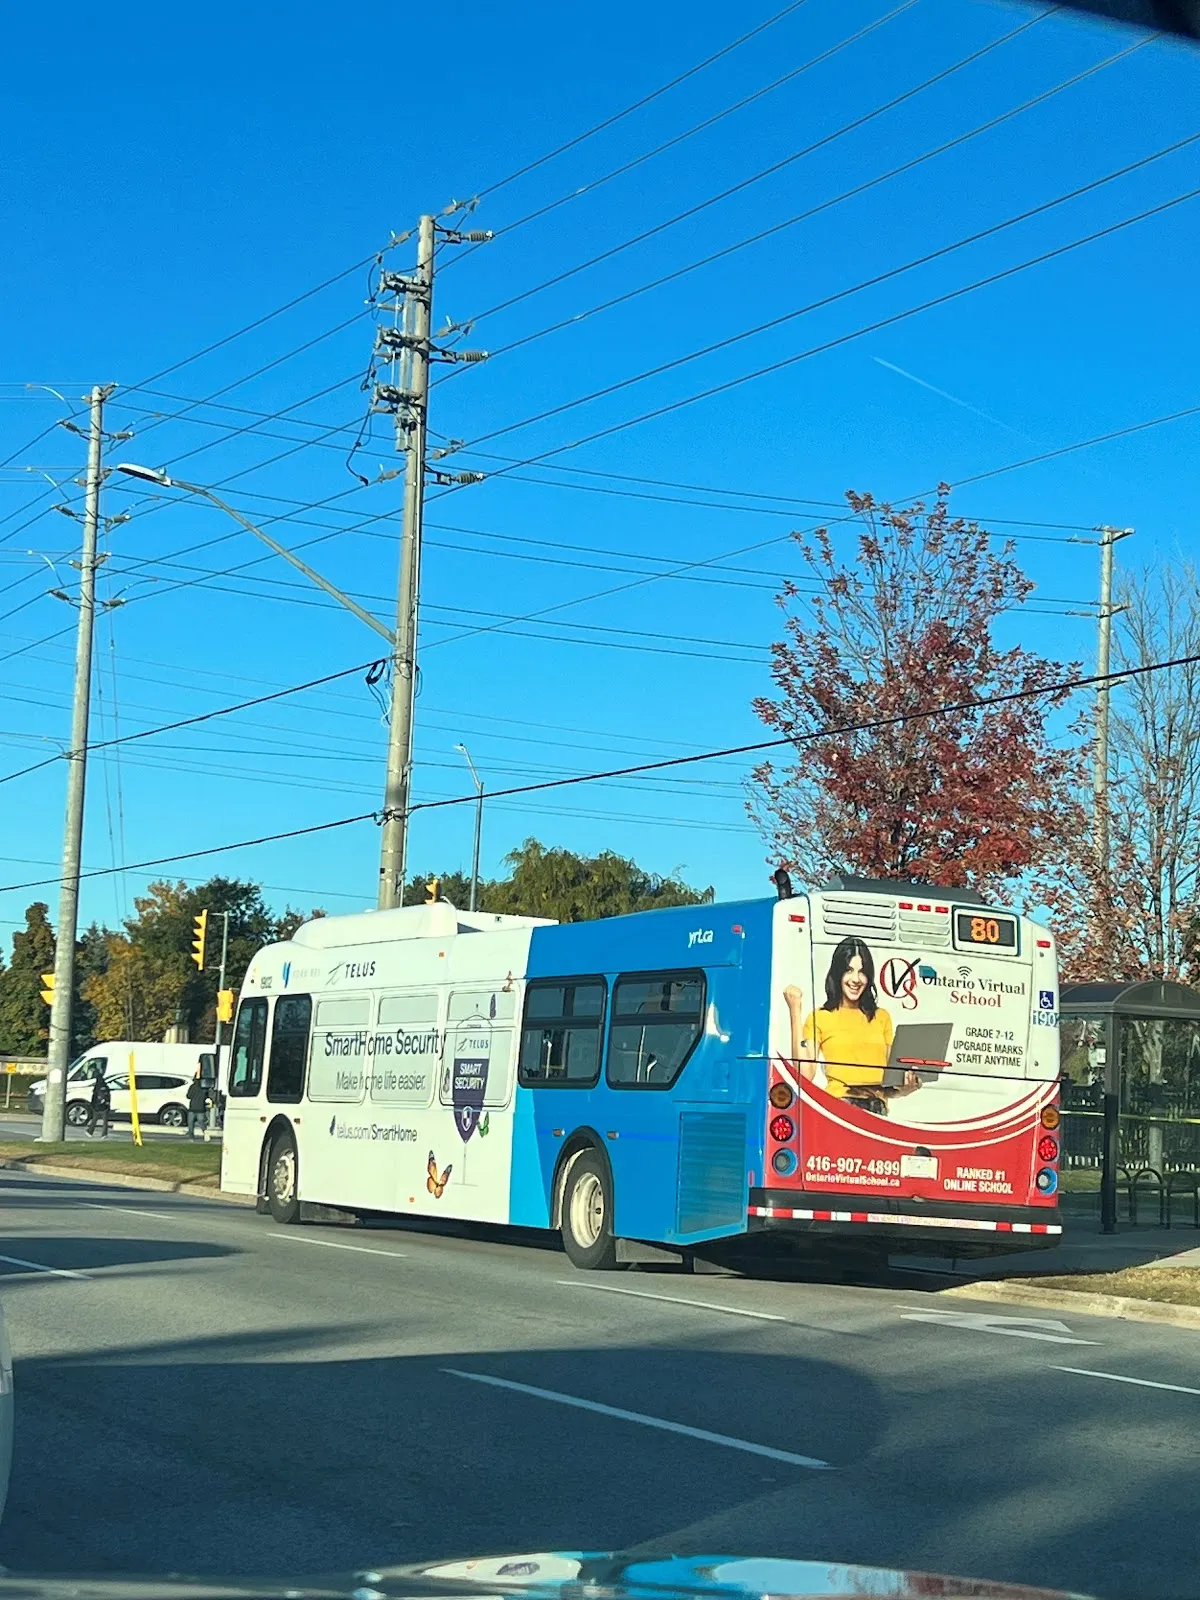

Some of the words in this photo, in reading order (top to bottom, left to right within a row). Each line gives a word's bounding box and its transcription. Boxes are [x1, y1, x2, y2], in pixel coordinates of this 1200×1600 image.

[688, 928, 714, 949] yrt.ca
[971, 917, 999, 943] 80
[345, 961, 376, 978] TELUS
[979, 978, 1026, 995] Virtual
[950, 990, 1002, 1008] School
[965, 1026, 993, 1039] GRADE
[995, 1029, 1014, 1041] 7-12
[325, 1031, 393, 1057] SmartHome
[395, 1028, 445, 1061] Security
[469, 1039, 489, 1049] TELUS
[953, 1040, 992, 1054] UPGRADE
[994, 1043, 1024, 1055] MARKS
[956, 1053, 982, 1065] START
[984, 1055, 1021, 1067] ANYTIME
[460, 1063, 482, 1075] SMART
[336, 1071, 359, 1090] Make
[360, 1071, 382, 1090] home
[384, 1070, 397, 1090] life
[398, 1071, 426, 1090] easier.
[455, 1076, 485, 1090] SECURITY
[336, 1122, 418, 1142] telus.com/SmartHome
[806, 1155, 900, 1175] 416-907-4899
[956, 1166, 993, 1180] RANKED
[994, 1170, 1006, 1181] #1
[805, 1172, 900, 1187] OntarioVirtualSchool.ca
[943, 1177, 976, 1192] ONLINE
[979, 1181, 1013, 1194] SCHOOL
